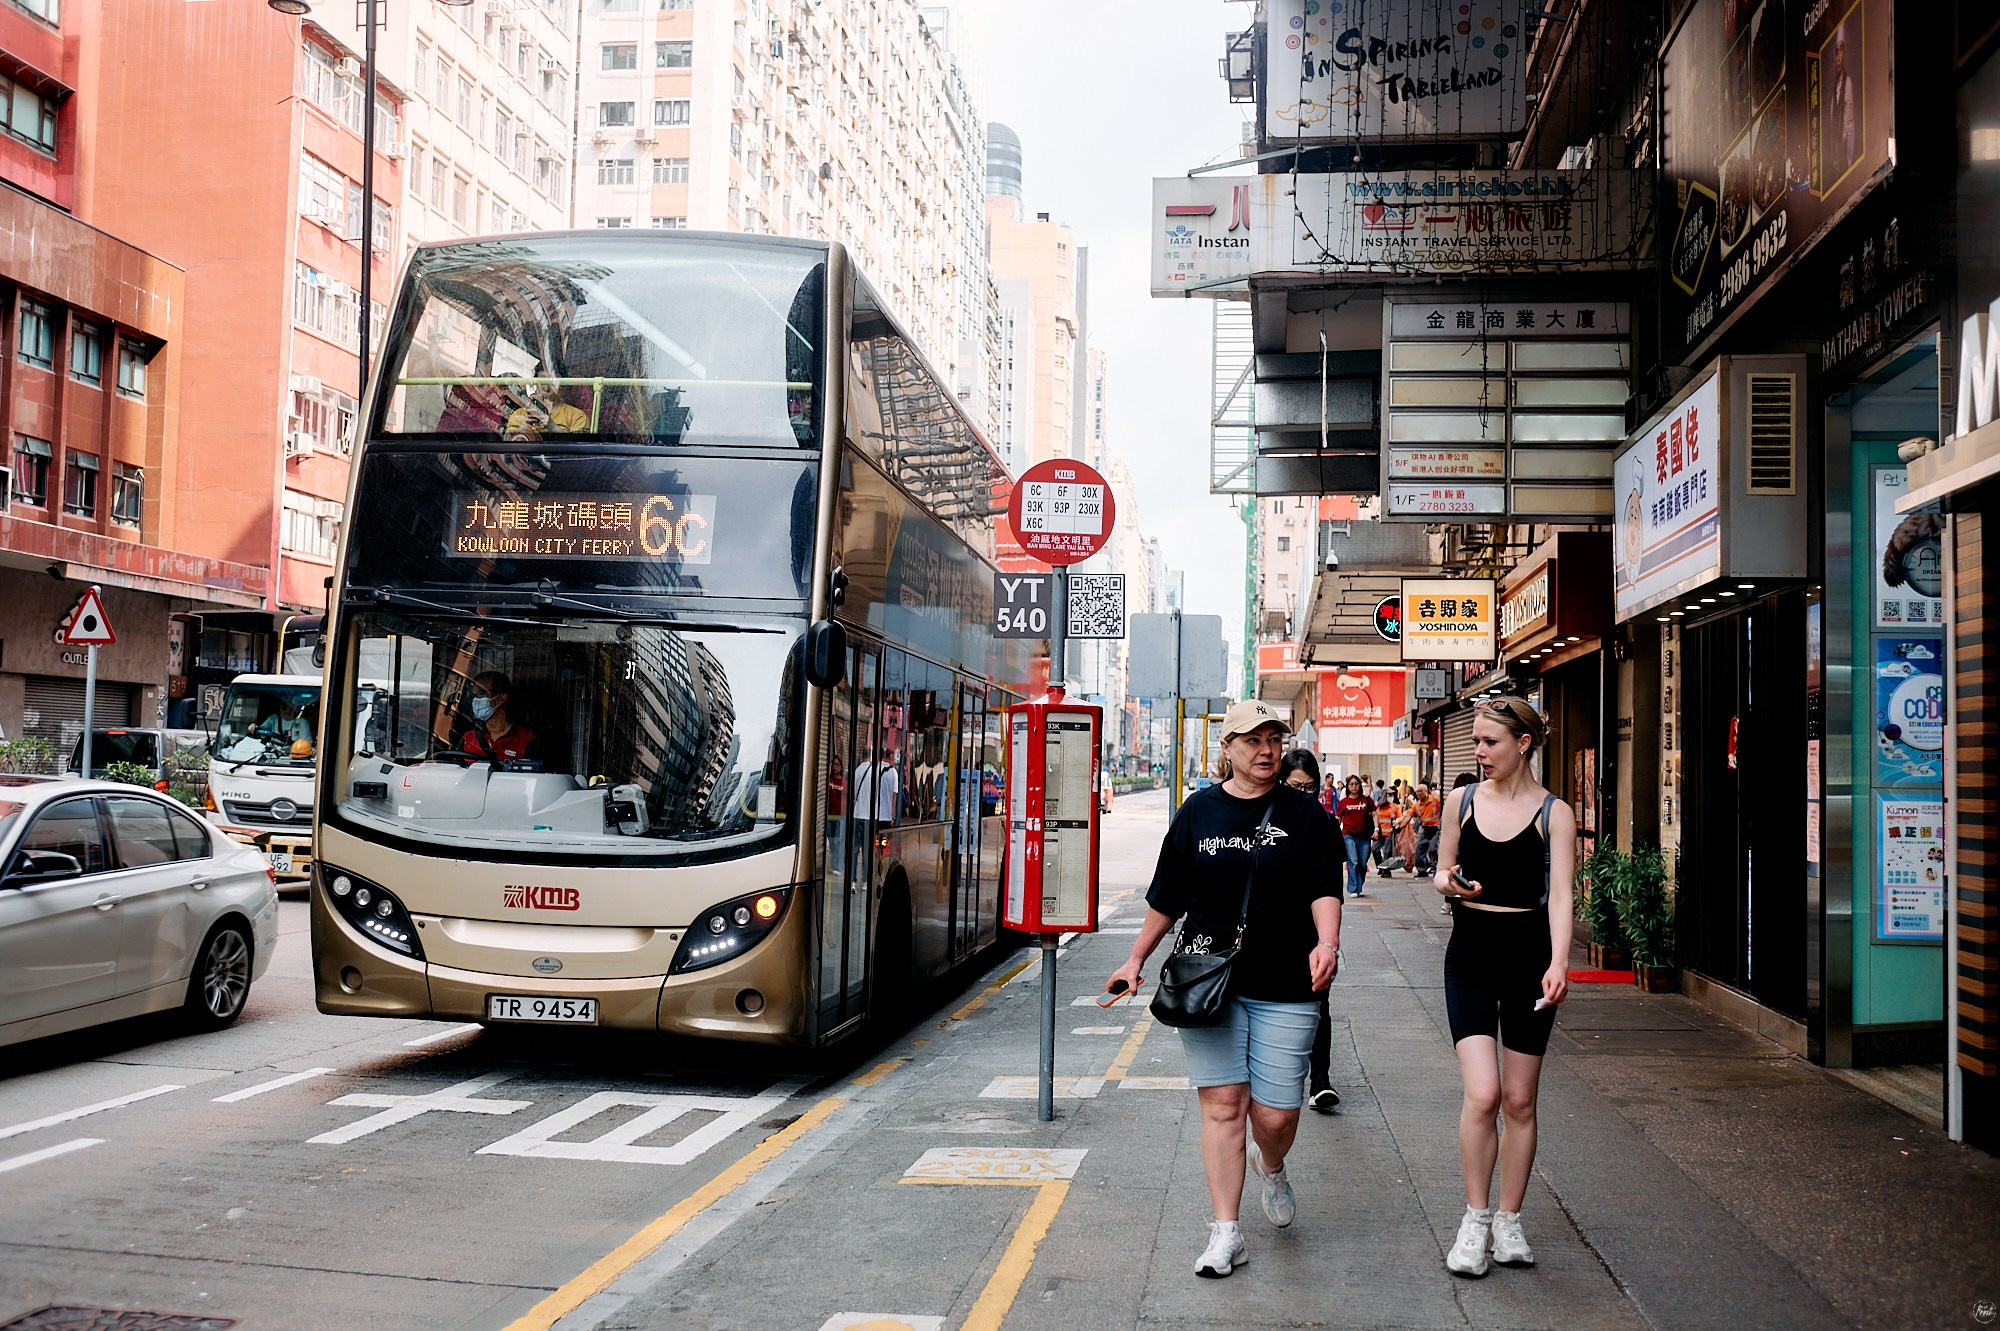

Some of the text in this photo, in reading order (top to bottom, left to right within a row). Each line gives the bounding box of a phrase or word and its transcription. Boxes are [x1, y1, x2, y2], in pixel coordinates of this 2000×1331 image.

[1350, 176, 1572, 197] www.airticket.hk
[1361, 235, 1575, 247] INSTANT TRAVEL SERVICE LTD.
[1720, 208, 1787, 310] 2986 9932
[1427, 310, 1596, 329] 金龍商業大廈
[1822, 311, 1871, 372] NATHAN
[1656, 405, 1699, 485] 泰國佬
[1055, 469, 1076, 480] KMB
[1030, 485, 1098, 499] 6C 6F 30X
[1395, 494, 1416, 506] 1/F
[1420, 502, 1475, 512] 2780 3233
[465, 500, 632, 531] 九龍城碼頭
[1027, 501, 1100, 515] 93K 93P 230X
[639, 495, 707, 556] 6C
[1026, 517, 1043, 529] X6C
[458, 537, 634, 555] KOWLOON CITY FERRY
[1000, 577, 1045, 603] YT
[997, 607, 1046, 632] 540
[1419, 623, 1478, 631] YOSHINOYA
[62, 651, 90, 666] OUTLE
[170, 681, 187, 693] 519
[222, 790, 251, 799] HINO
[1887, 805, 1919, 815] Kumon
[271, 854, 283, 862] UF
[524, 885, 580, 911] KMB
[494, 999, 592, 1020] TR 9454
[918, 1160, 1071, 1176] 230X
